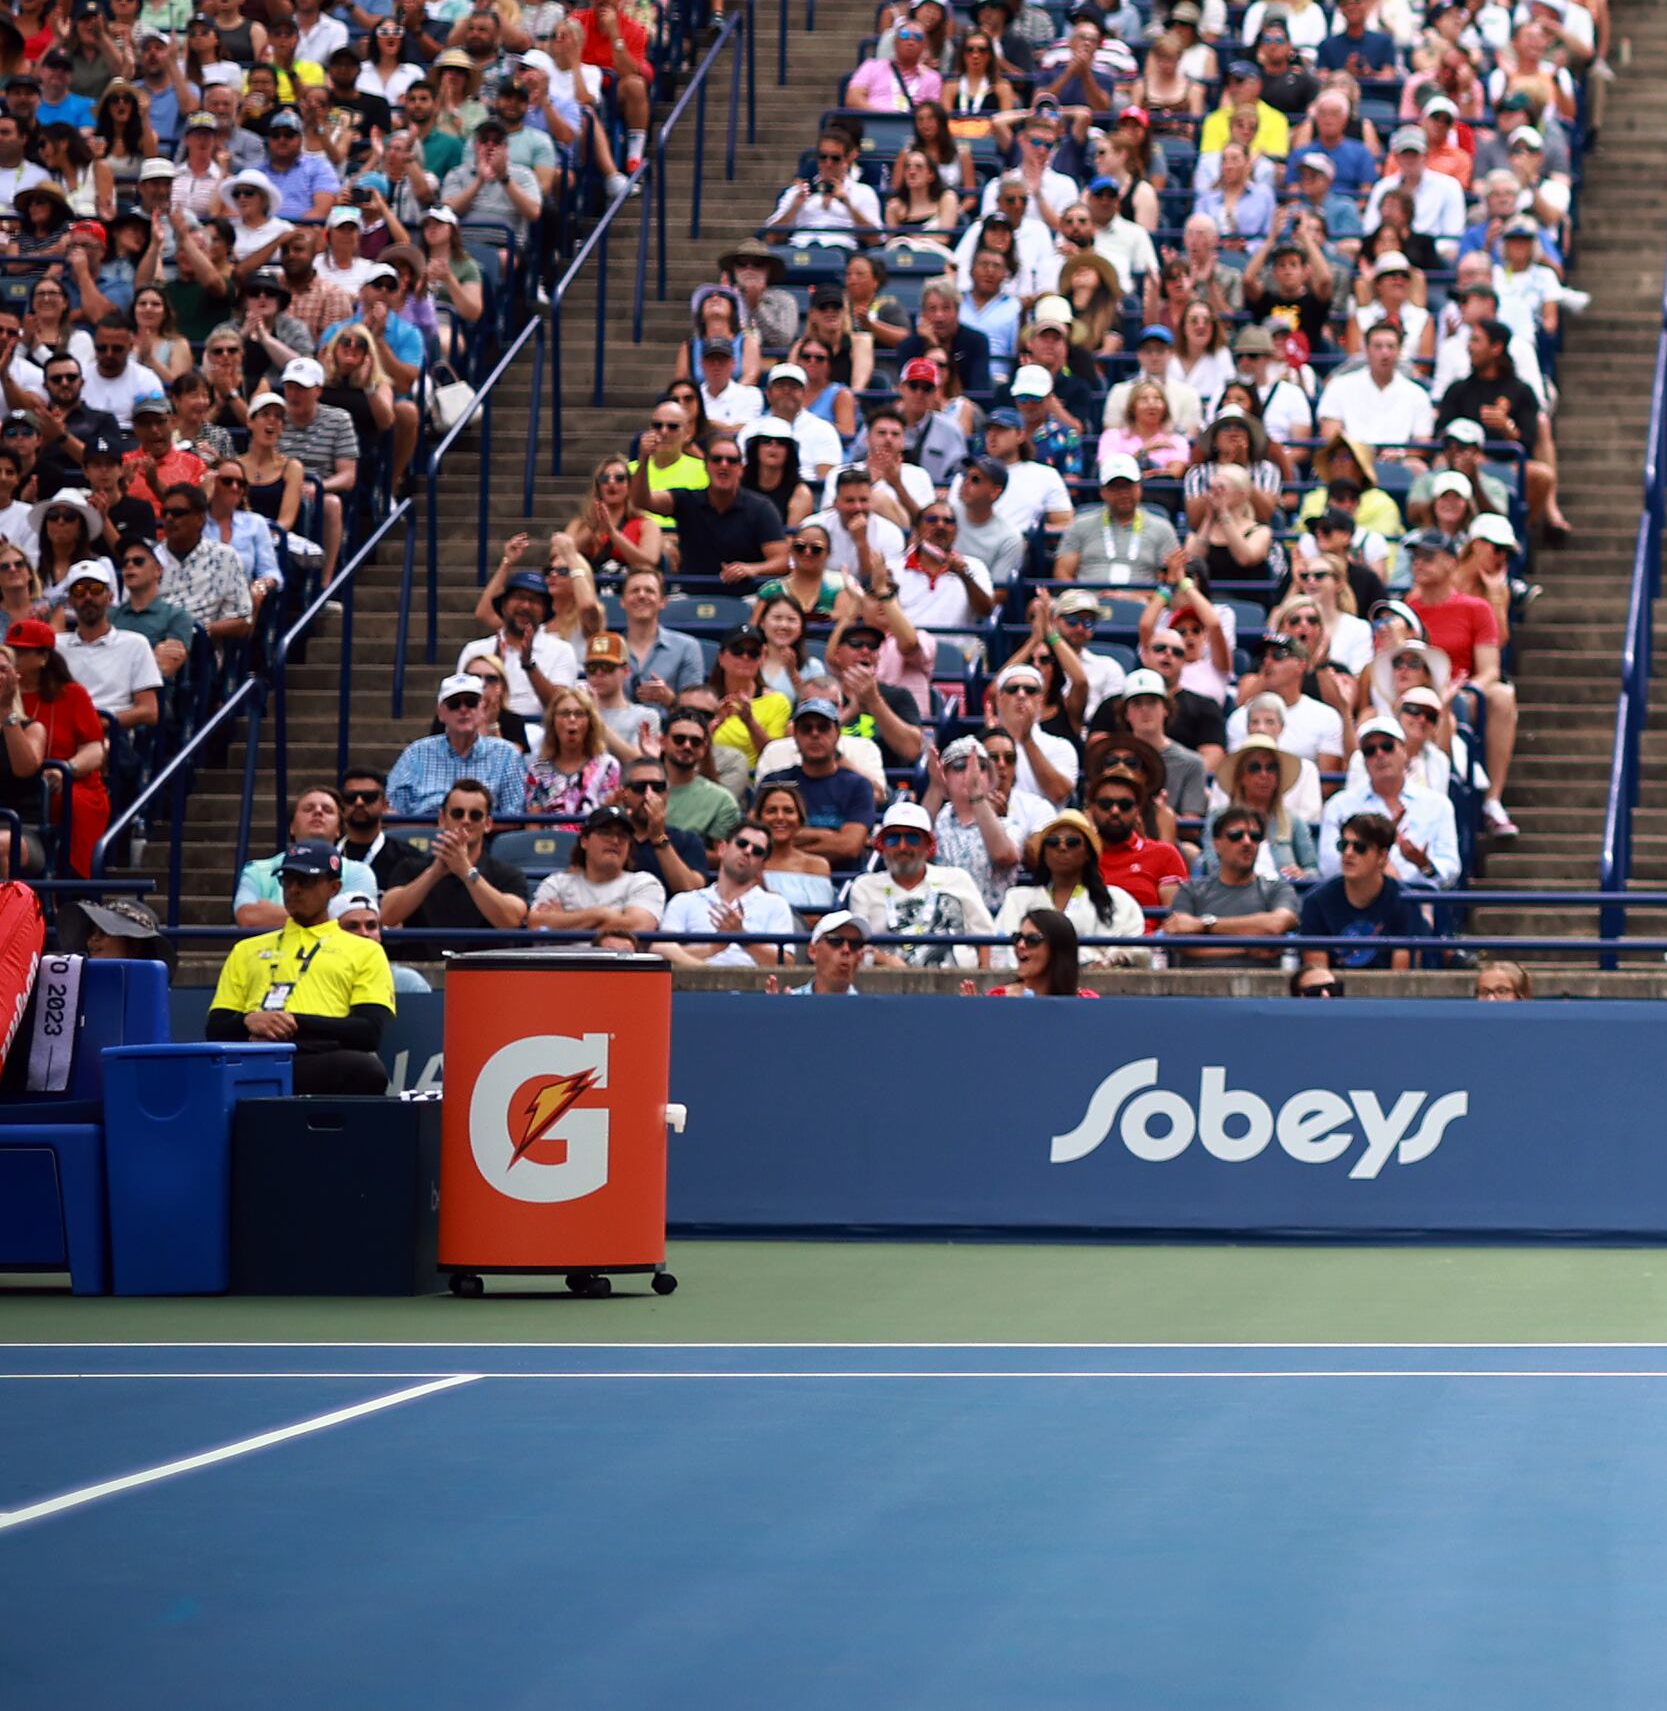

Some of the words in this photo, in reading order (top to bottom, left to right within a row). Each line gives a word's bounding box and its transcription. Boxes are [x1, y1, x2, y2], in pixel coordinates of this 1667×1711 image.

[44, 984, 67, 1037] 2023
[469, 1032, 610, 1204] G
[1050, 1057, 1469, 1180] Sobeys
